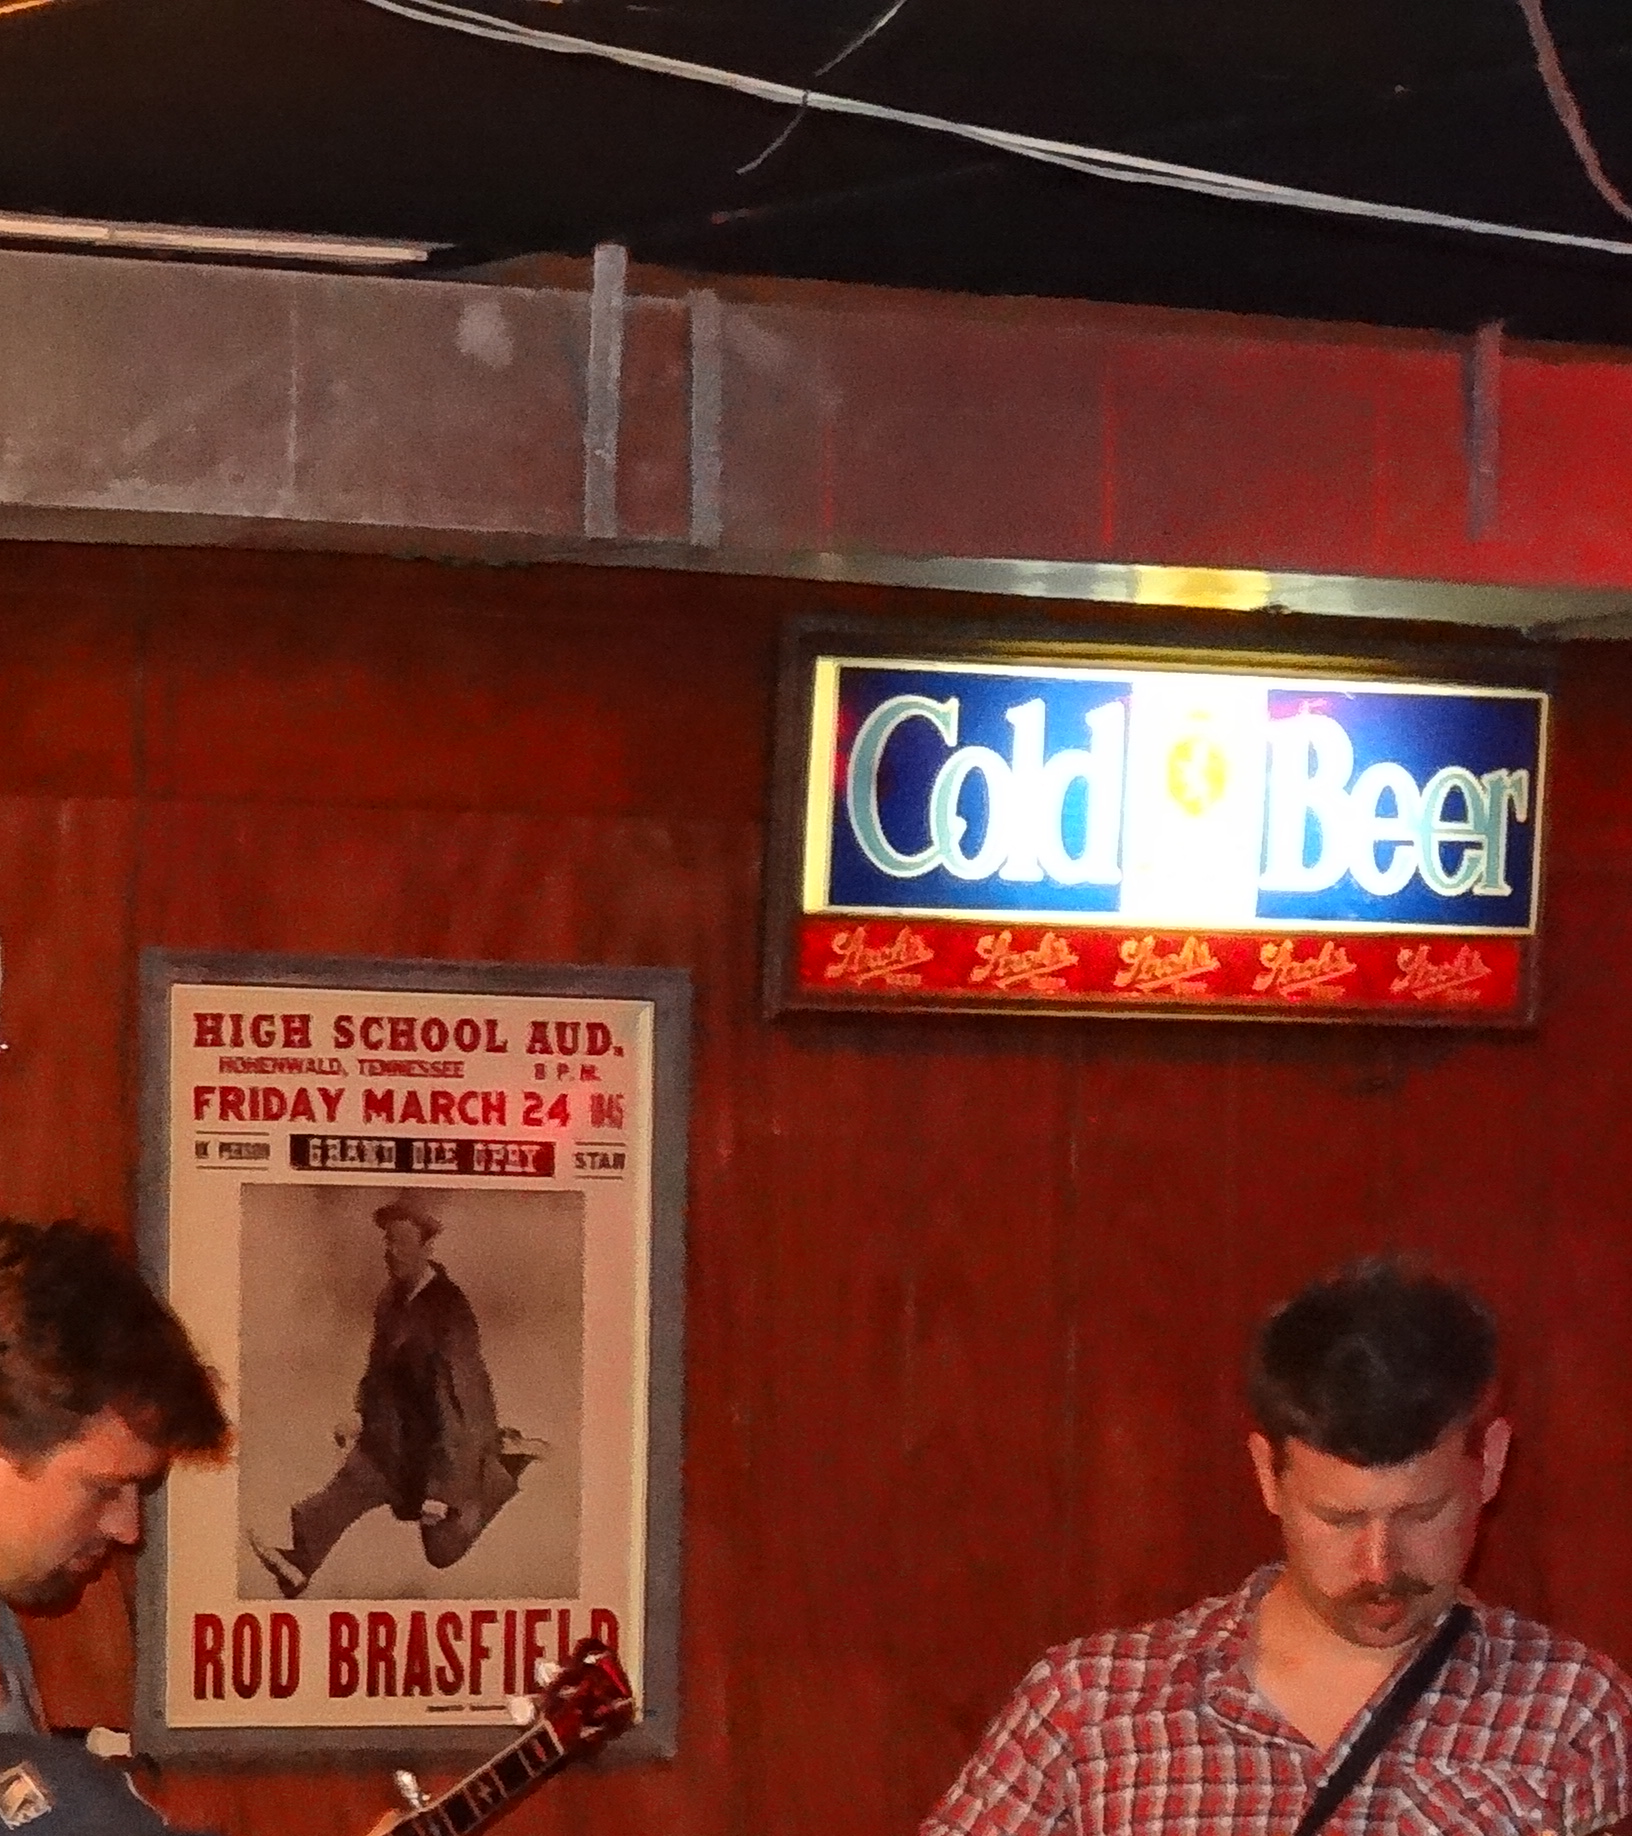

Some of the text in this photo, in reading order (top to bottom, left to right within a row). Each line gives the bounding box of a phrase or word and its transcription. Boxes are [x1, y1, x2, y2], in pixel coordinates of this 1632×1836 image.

[847, 695, 1531, 898] Cold Beer
[193, 1012, 624, 1057] HIGH SCHOOL AUD.
[193, 1085, 344, 1123] FRIDAY
[362, 1088, 507, 1127] MARCH
[522, 1090, 571, 1128] 24
[194, 1612, 300, 1700] ROD
